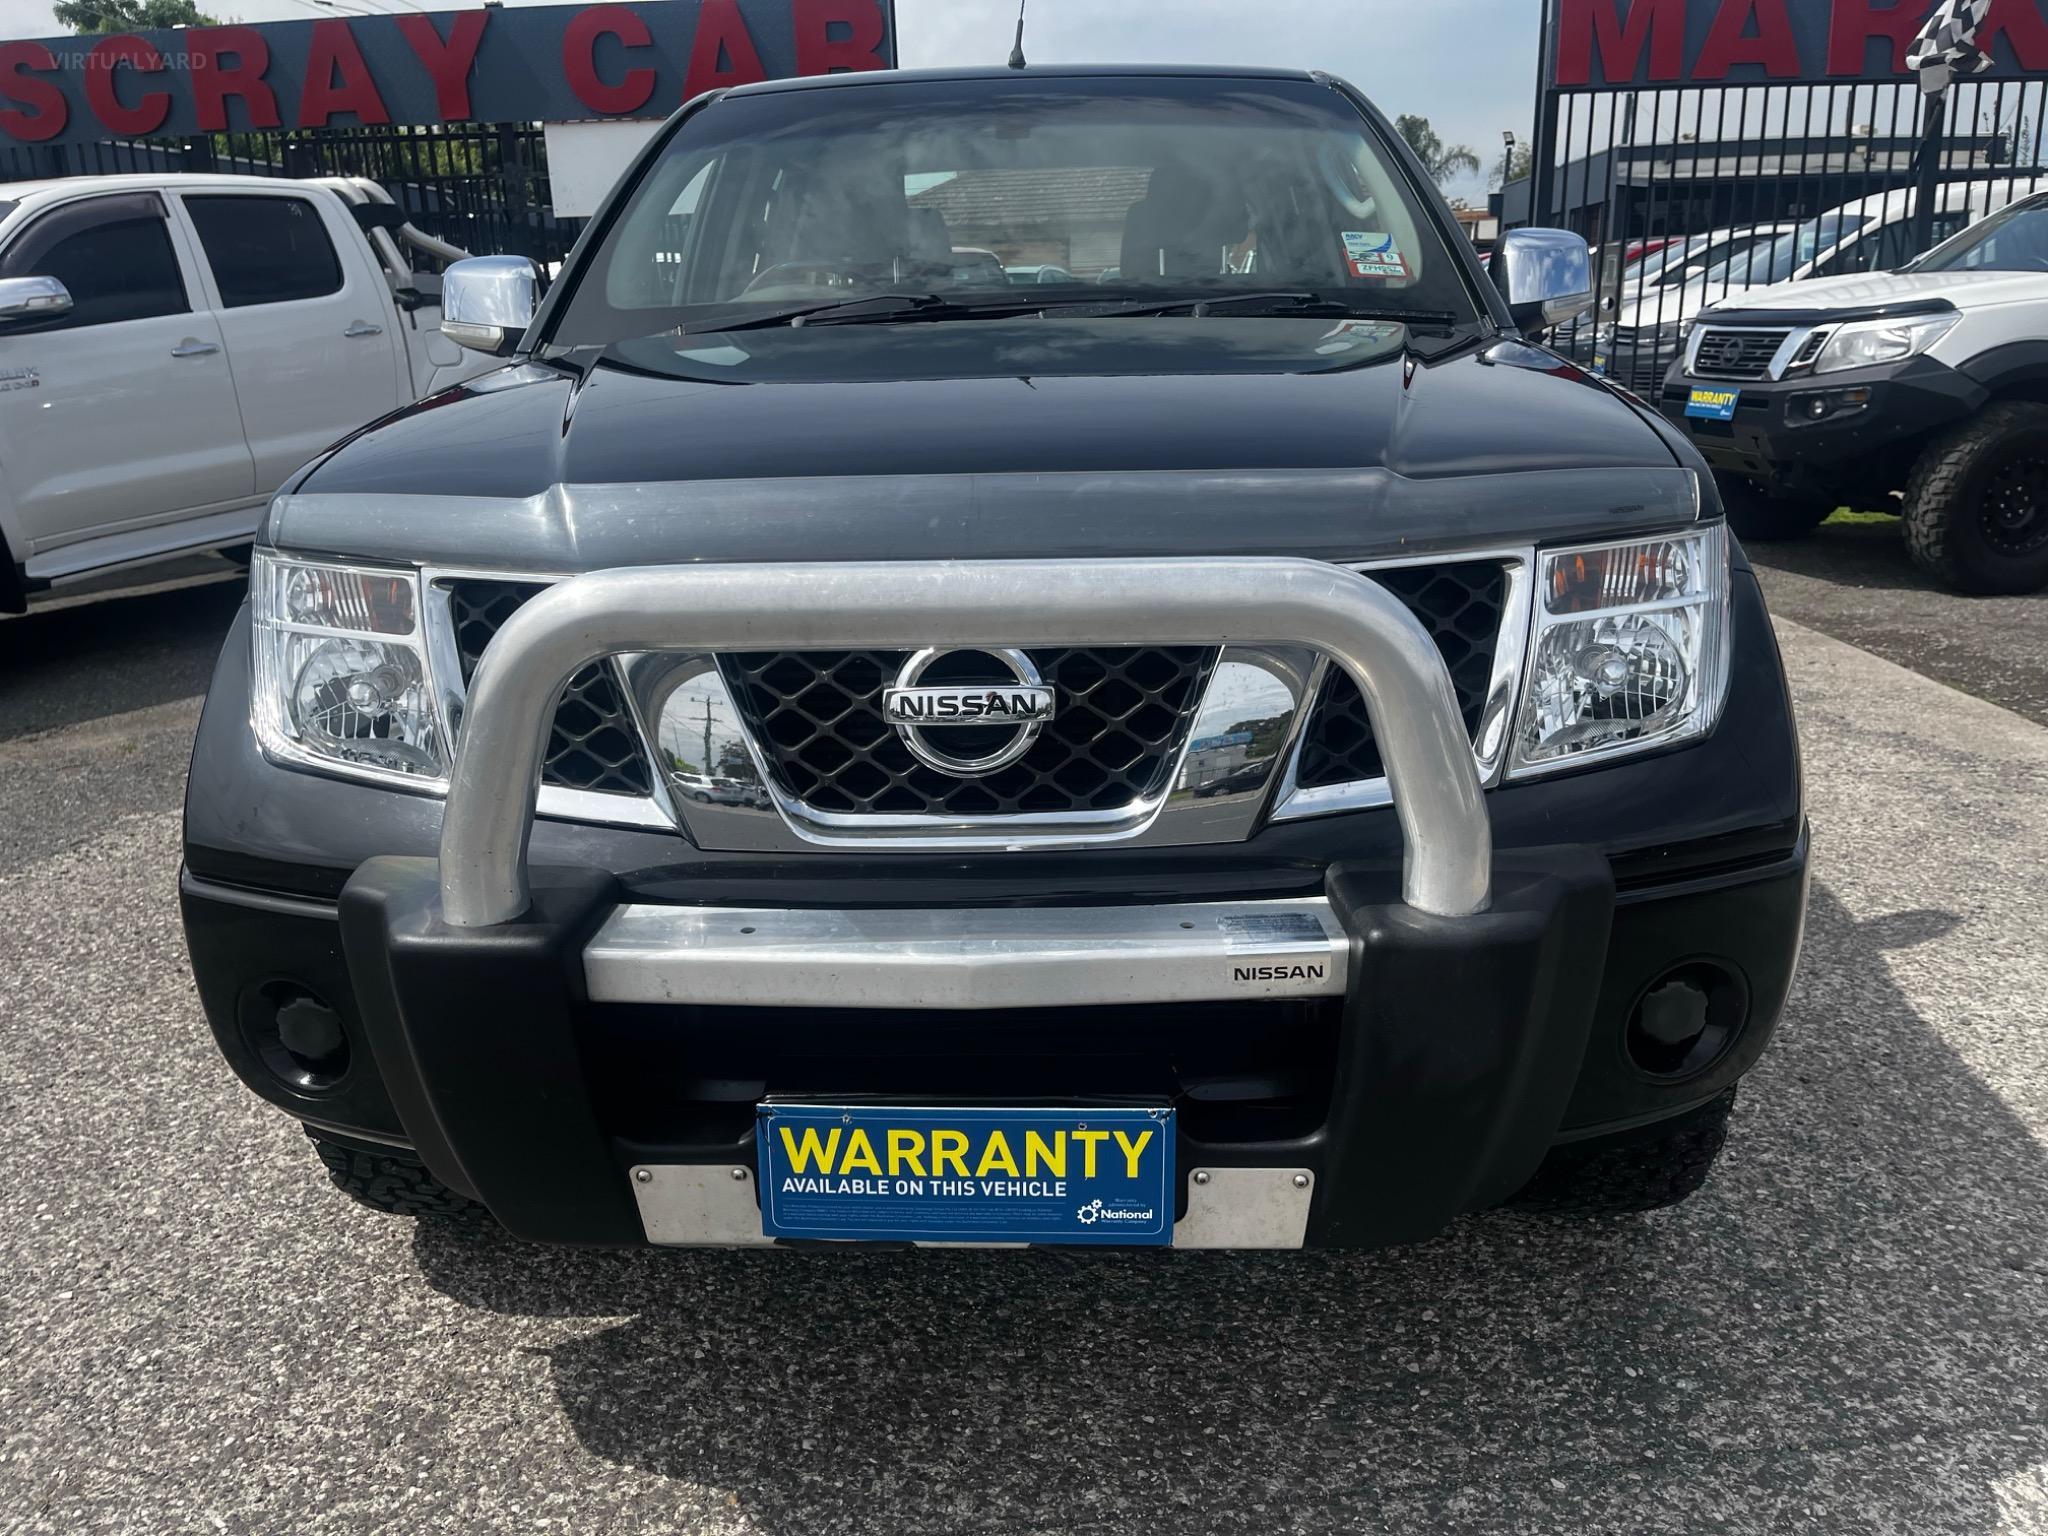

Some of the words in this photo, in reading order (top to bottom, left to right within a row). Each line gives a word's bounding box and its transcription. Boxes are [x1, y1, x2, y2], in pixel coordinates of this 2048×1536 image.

[562, 0, 888, 114] CAR
[1691, 391, 1736, 406] WARRANTY
[900, 693, 1036, 717] NISSAN
[1233, 965, 1323, 981] NISSAN
[779, 1127, 1154, 1178] WARRANTY
[782, 1178, 889, 1195] AVAILABLE
[895, 1180, 923, 1196] ON
[930, 1181, 975, 1197] THIS
[979, 1181, 1067, 1197] VEHICLE
[1100, 1208, 1153, 1219] National
